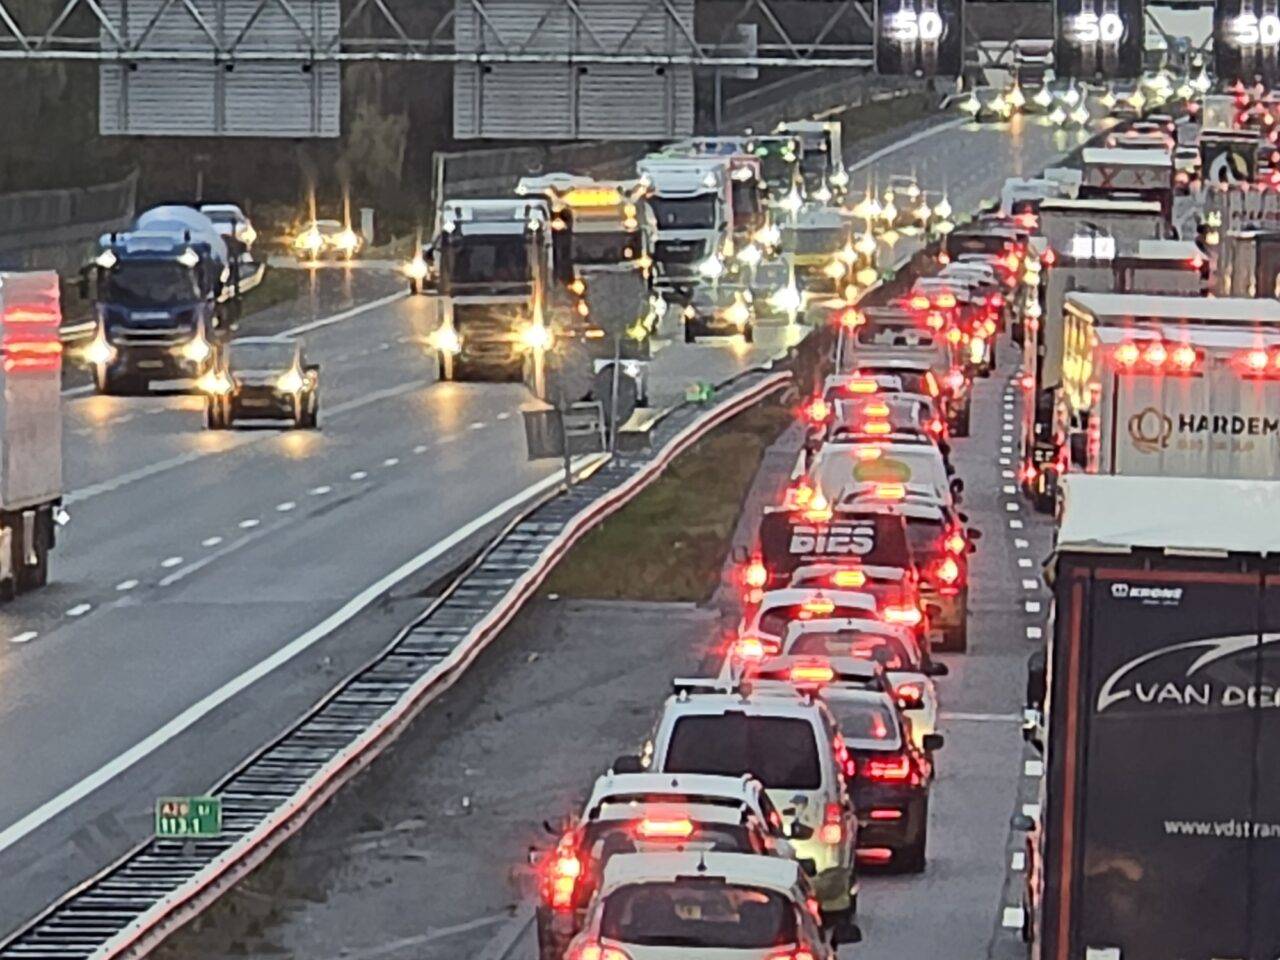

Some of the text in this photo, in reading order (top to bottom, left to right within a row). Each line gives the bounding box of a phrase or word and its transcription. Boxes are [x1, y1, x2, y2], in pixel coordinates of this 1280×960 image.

[897, 13, 943, 40] 50
[1078, 14, 1124, 41] 50
[1136, 683, 1210, 704] VAN
